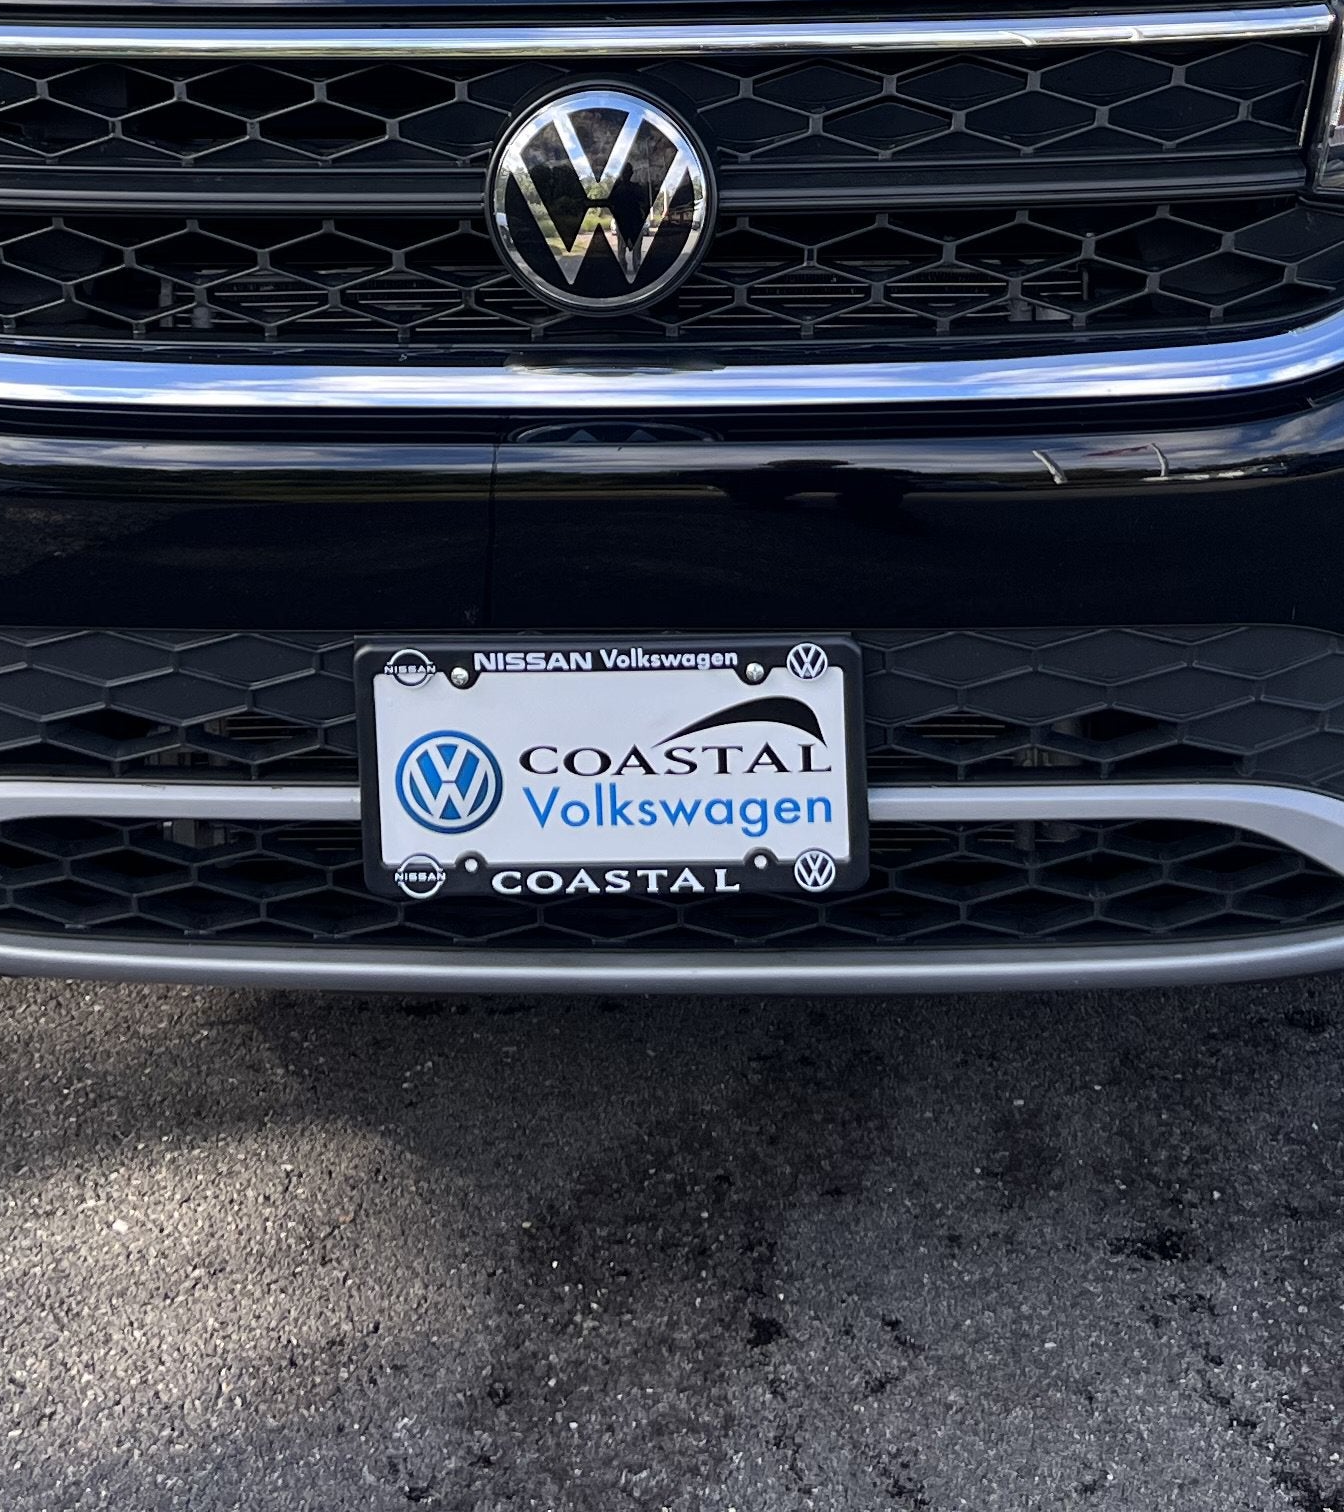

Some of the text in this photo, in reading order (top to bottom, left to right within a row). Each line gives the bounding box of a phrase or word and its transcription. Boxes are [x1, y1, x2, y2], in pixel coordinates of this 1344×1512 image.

[384, 663, 437, 675] NISSAN
[474, 647, 738, 671] NISSAN Volkswagen
[519, 741, 832, 776] COASTAL
[522, 782, 832, 838] Volkswagen
[394, 870, 446, 883] NISSAN
[492, 868, 740, 894] COASTAL
